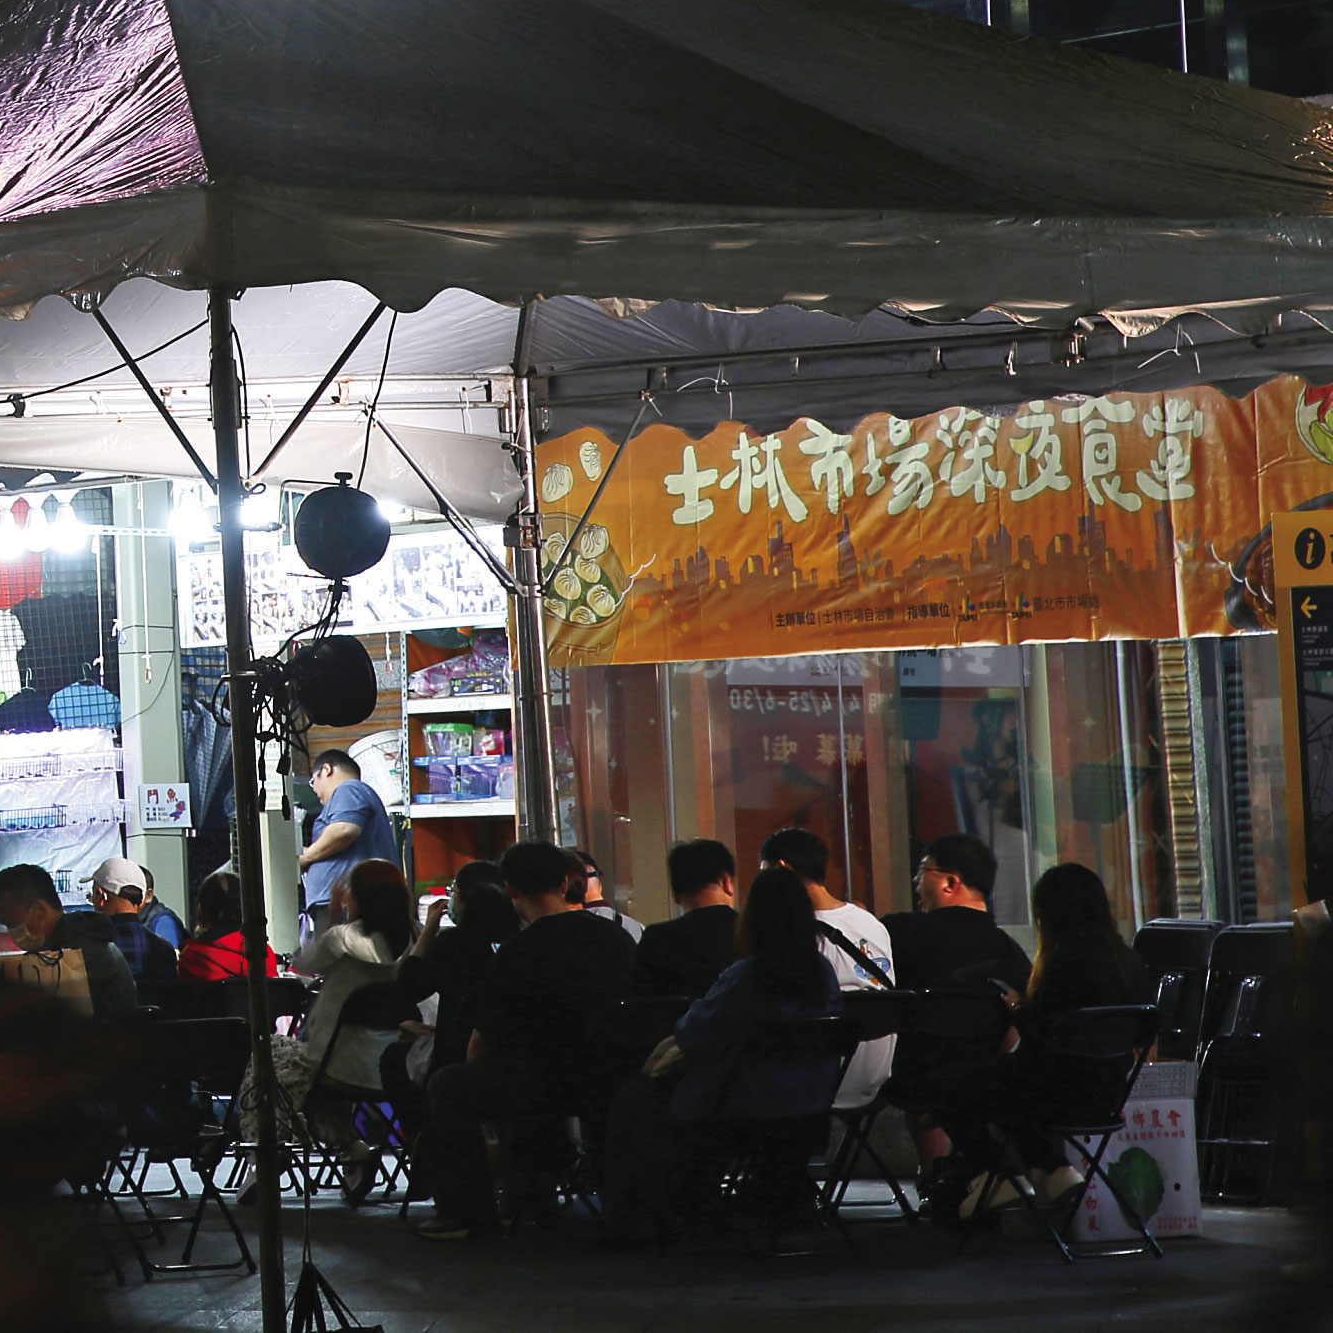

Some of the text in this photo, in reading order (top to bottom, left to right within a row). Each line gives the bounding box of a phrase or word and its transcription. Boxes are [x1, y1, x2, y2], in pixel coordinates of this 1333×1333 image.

[664, 396, 1205, 524] 士林市場深夜食堂
